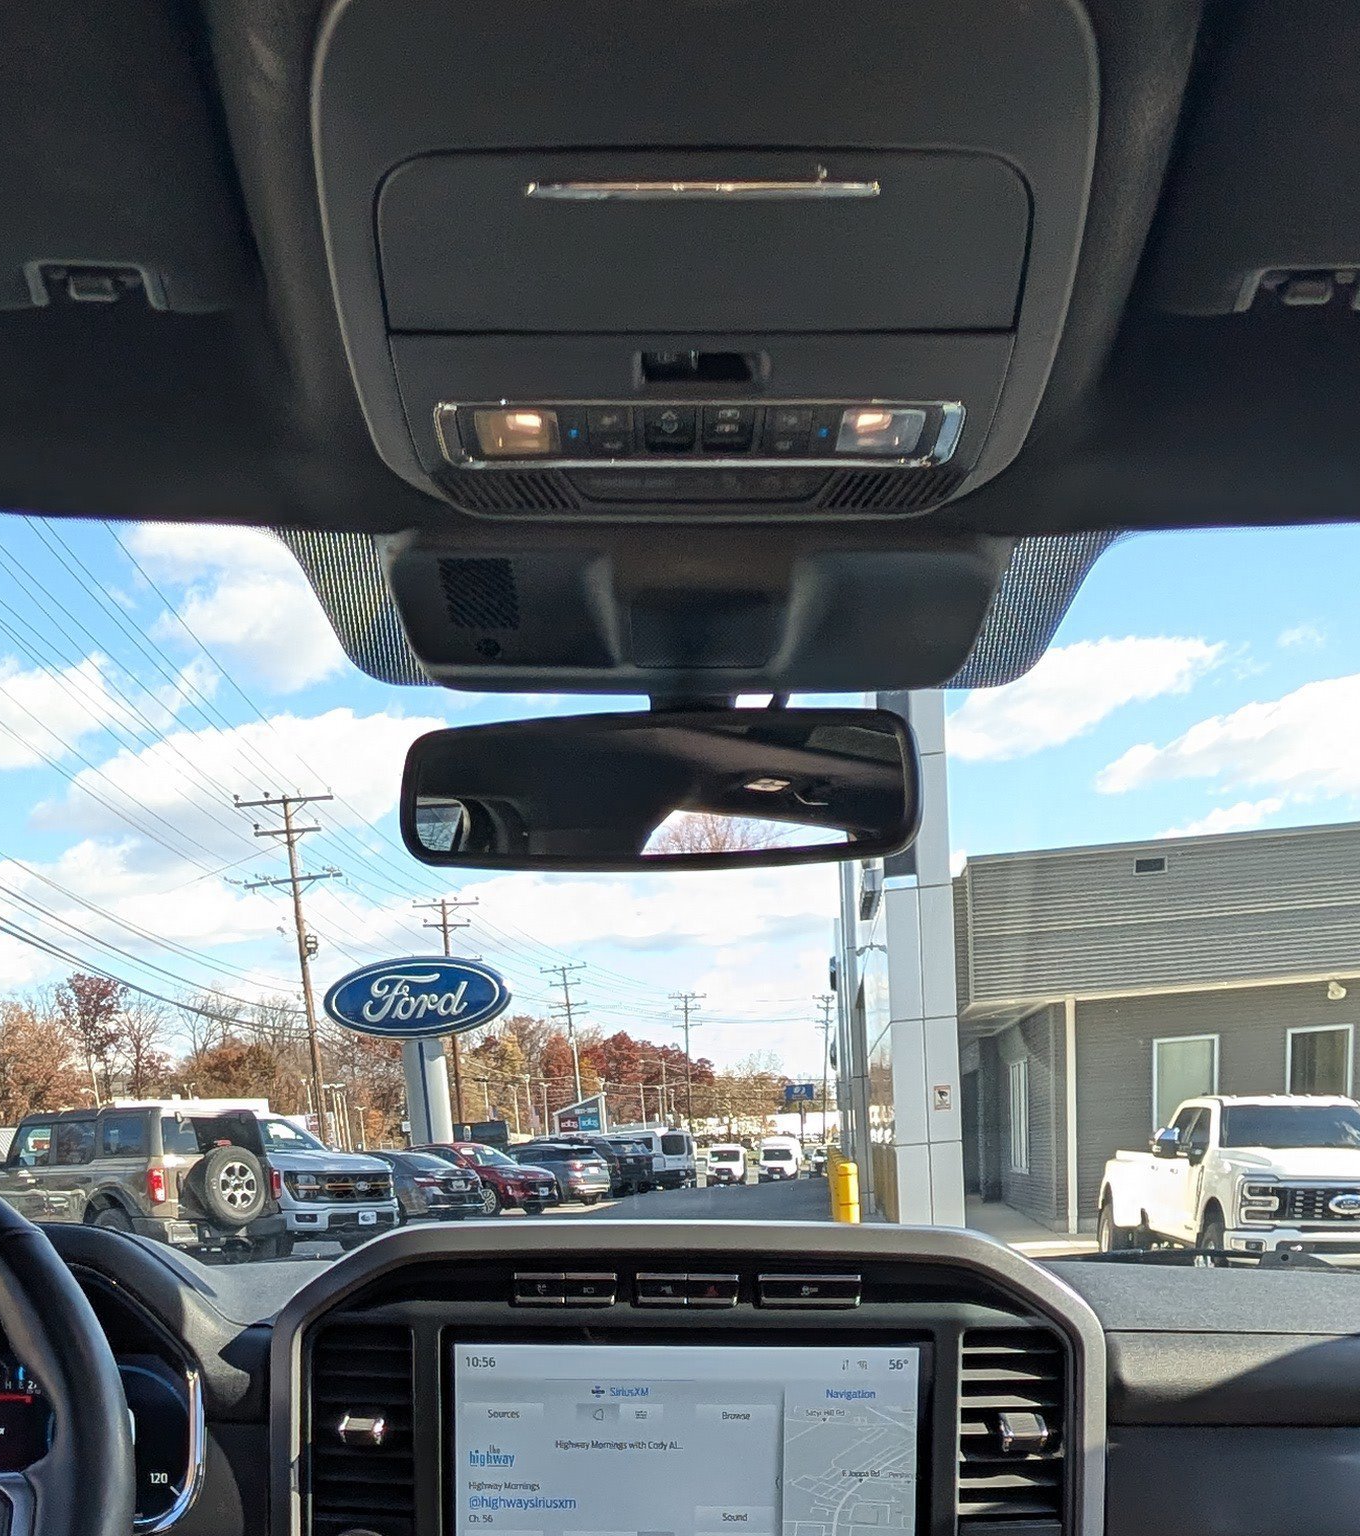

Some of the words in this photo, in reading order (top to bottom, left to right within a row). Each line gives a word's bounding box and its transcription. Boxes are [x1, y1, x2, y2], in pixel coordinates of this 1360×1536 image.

[362, 973, 468, 1023] Ford
[465, 1356, 496, 1368] 10:56
[888, 1359, 909, 1370] 56°
[610, 1387, 649, 1397] SiriusXM
[826, 1389, 876, 1400] Navigation
[488, 1409, 520, 1418] Sources
[722, 1412, 751, 1420] Browse
[555, 1440, 589, 1451] Highway
[591, 1440, 627, 1451] Mornings
[629, 1441, 646, 1449] with
[648, 1441, 667, 1451] Cody
[469, 1449, 515, 1467] highway
[150, 1473, 168, 1483] 120
[468, 1482, 502, 1491] Highway
[504, 1482, 540, 1491] Mornings
[469, 1496, 576, 1510] @highwaysiriusxm
[483, 1515, 493, 1523] 56
[722, 1513, 748, 1521] Sound
